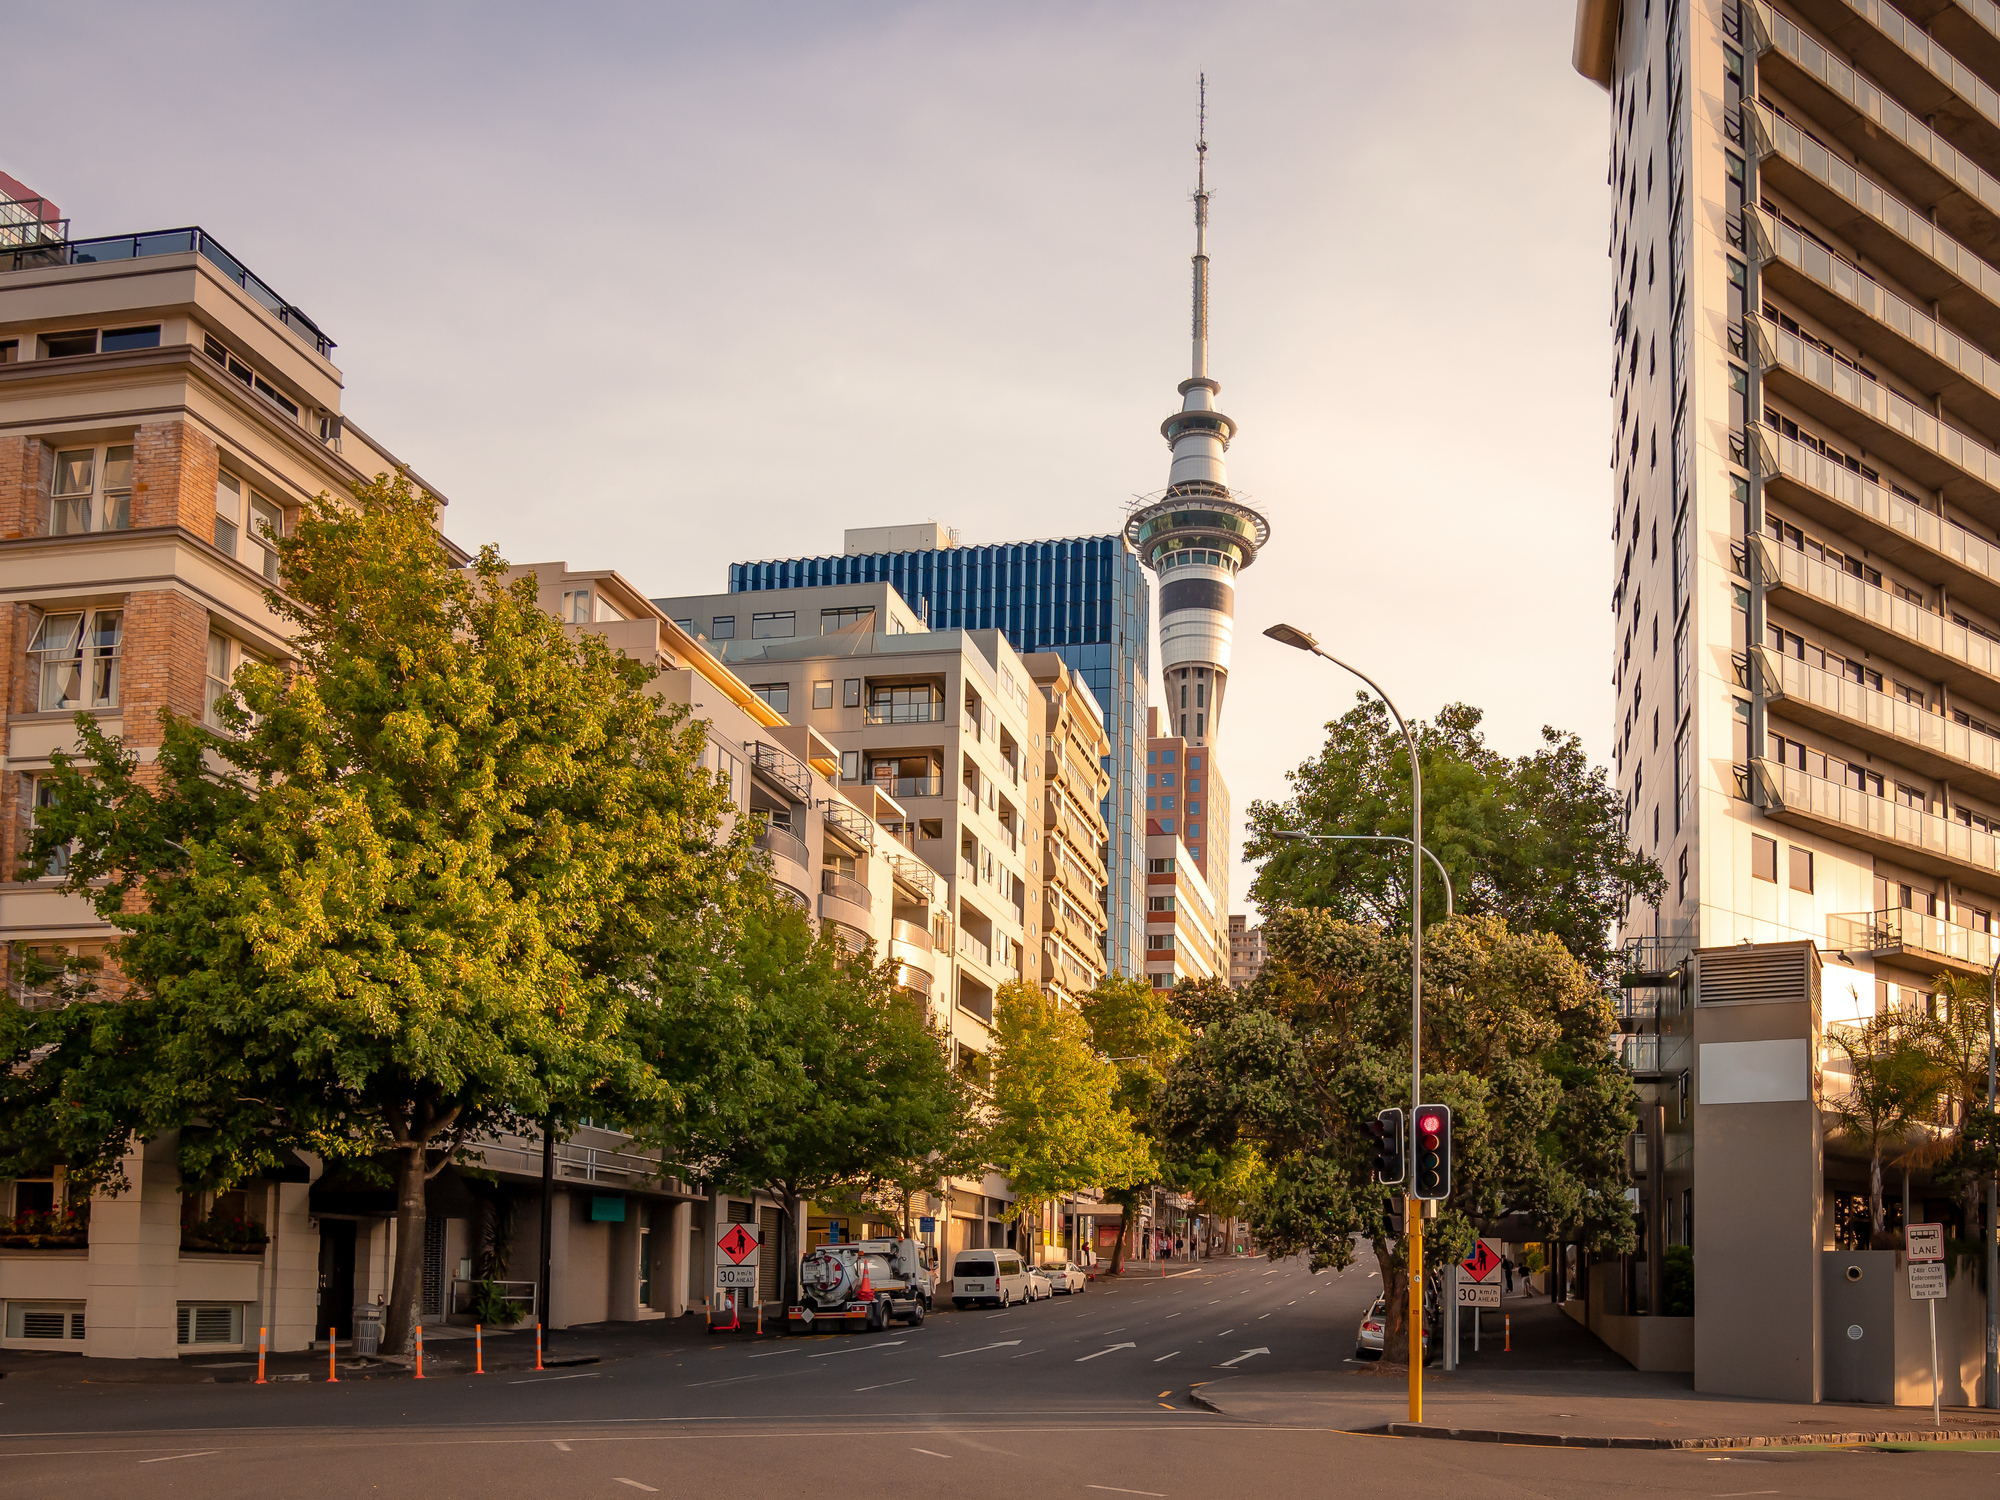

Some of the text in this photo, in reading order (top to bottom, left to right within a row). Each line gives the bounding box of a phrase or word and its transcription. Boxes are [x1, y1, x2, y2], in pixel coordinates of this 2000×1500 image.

[1912, 1245, 1938, 1255] LANE
[720, 1271, 735, 1283] 30
[1459, 1288, 1477, 1301] 30
